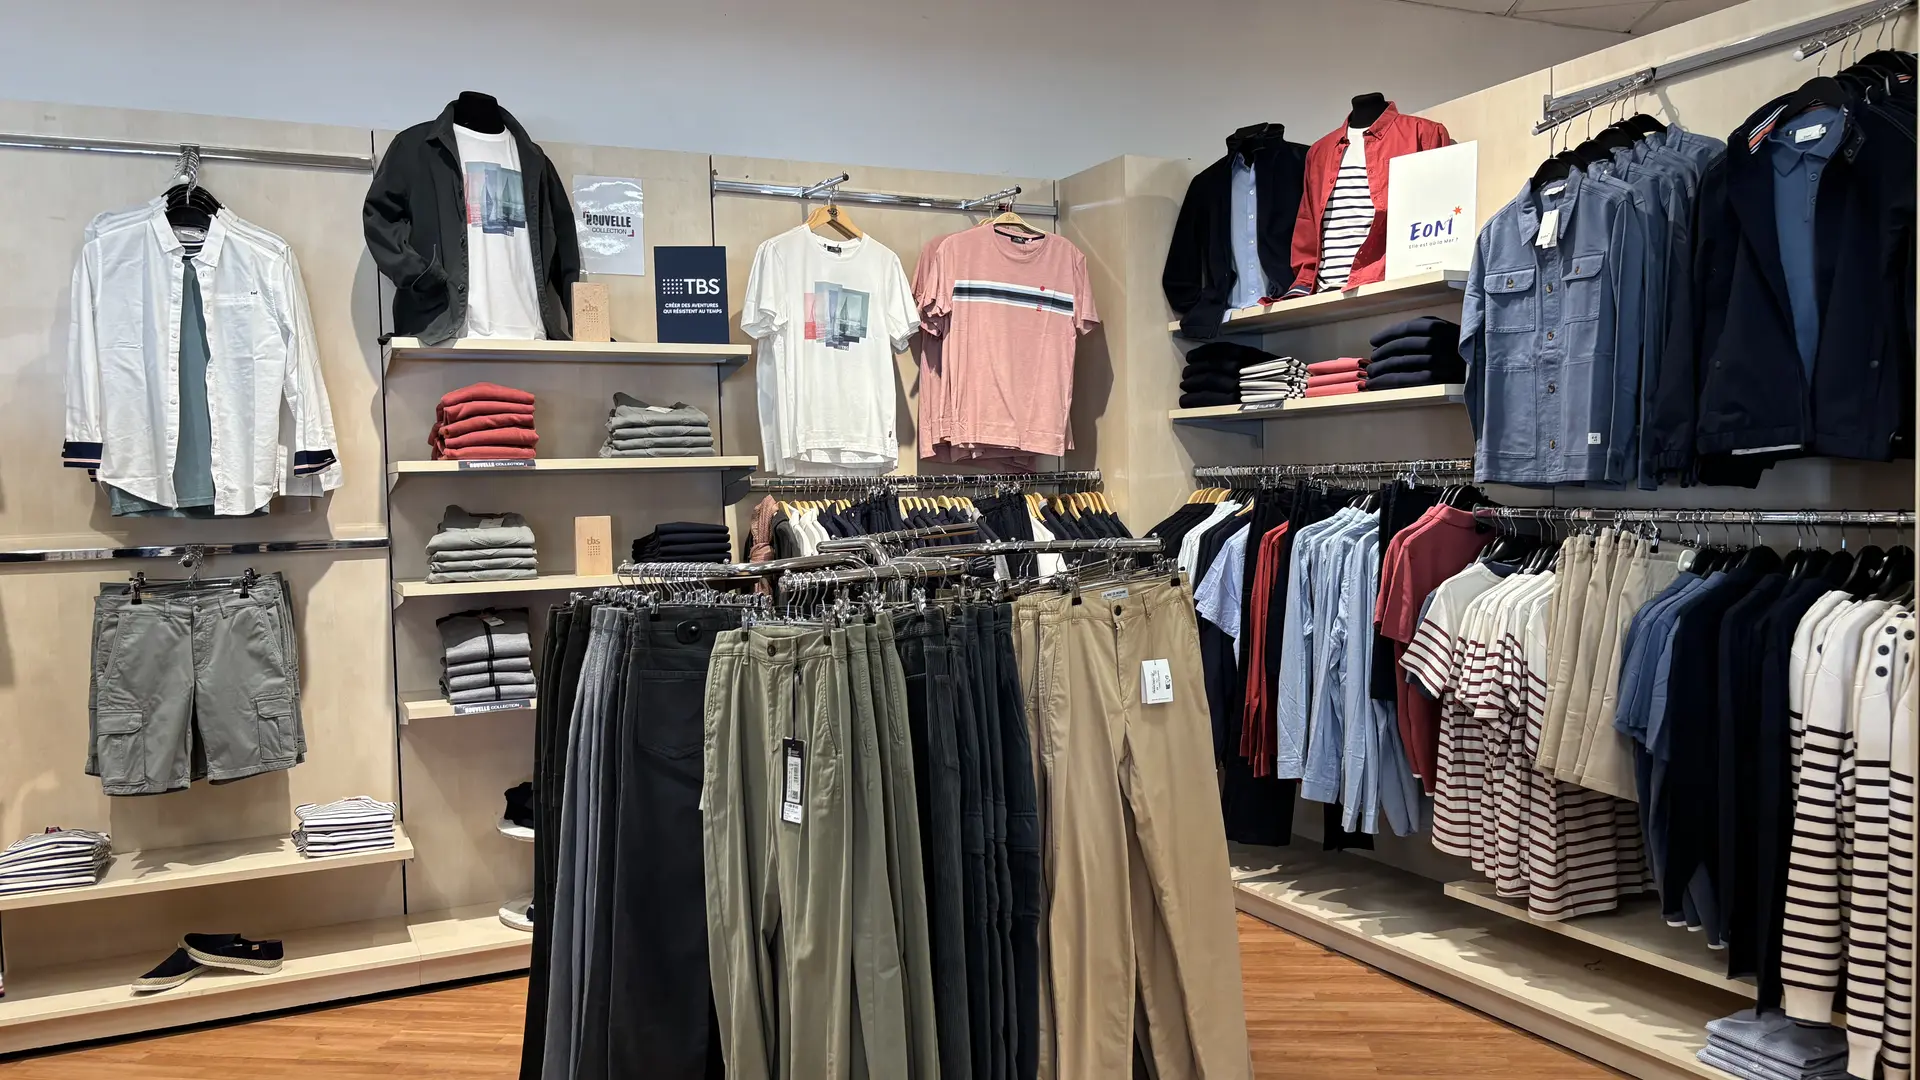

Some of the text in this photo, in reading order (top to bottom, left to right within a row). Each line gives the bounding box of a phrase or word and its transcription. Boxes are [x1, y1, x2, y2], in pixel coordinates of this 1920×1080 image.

[586, 214, 631, 227] NOUVELLE
[683, 278, 720, 295] TBS
[586, 536, 601, 545] tbs
